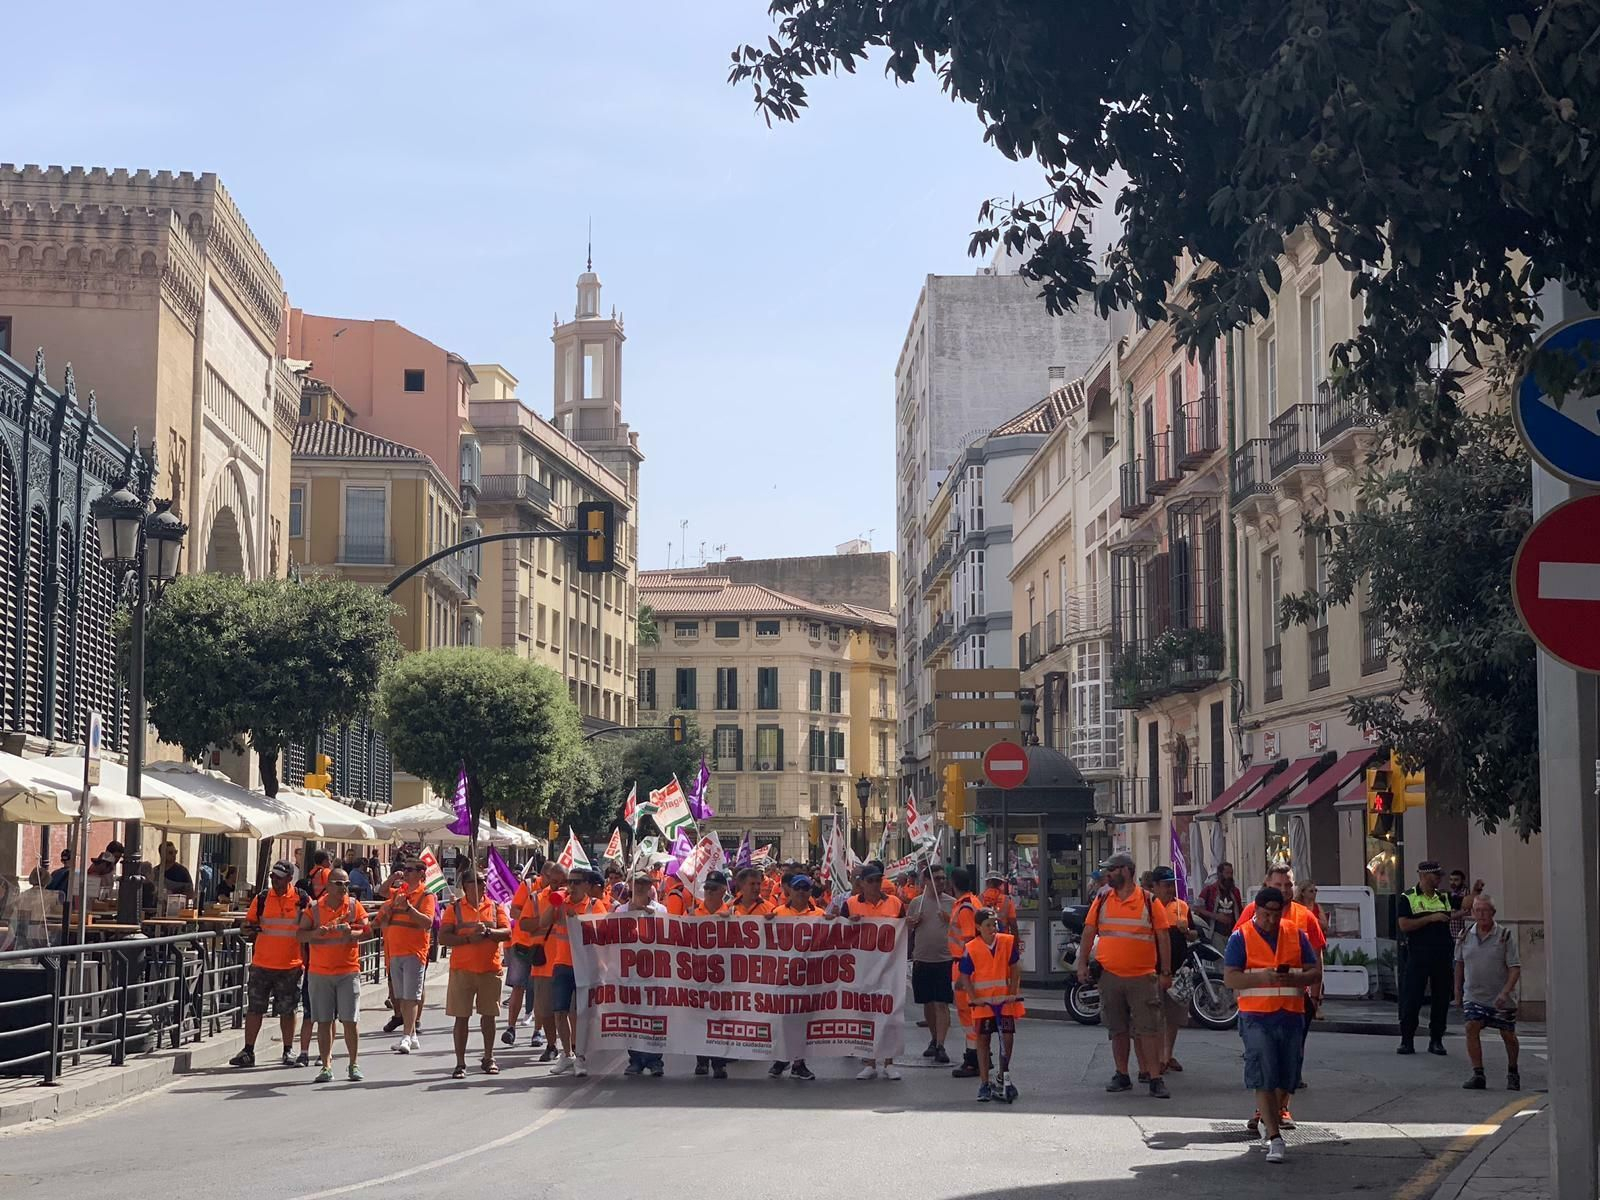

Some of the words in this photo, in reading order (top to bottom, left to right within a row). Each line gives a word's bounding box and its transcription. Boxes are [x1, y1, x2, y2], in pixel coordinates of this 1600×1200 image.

[581, 916, 760, 949] AMBULANCIAS
[764, 922, 896, 952] LUCHANDO
[620, 949, 671, 978] POR
[676, 951, 725, 983] SUS
[730, 953, 856, 986] DERECHOS
[588, 984, 616, 1008] POR
[619, 985, 641, 1005] UN
[644, 986, 751, 1011] TRANSPORTE
[754, 990, 838, 1015] SANITARIO
[842, 990, 894, 1015] DIGNO
